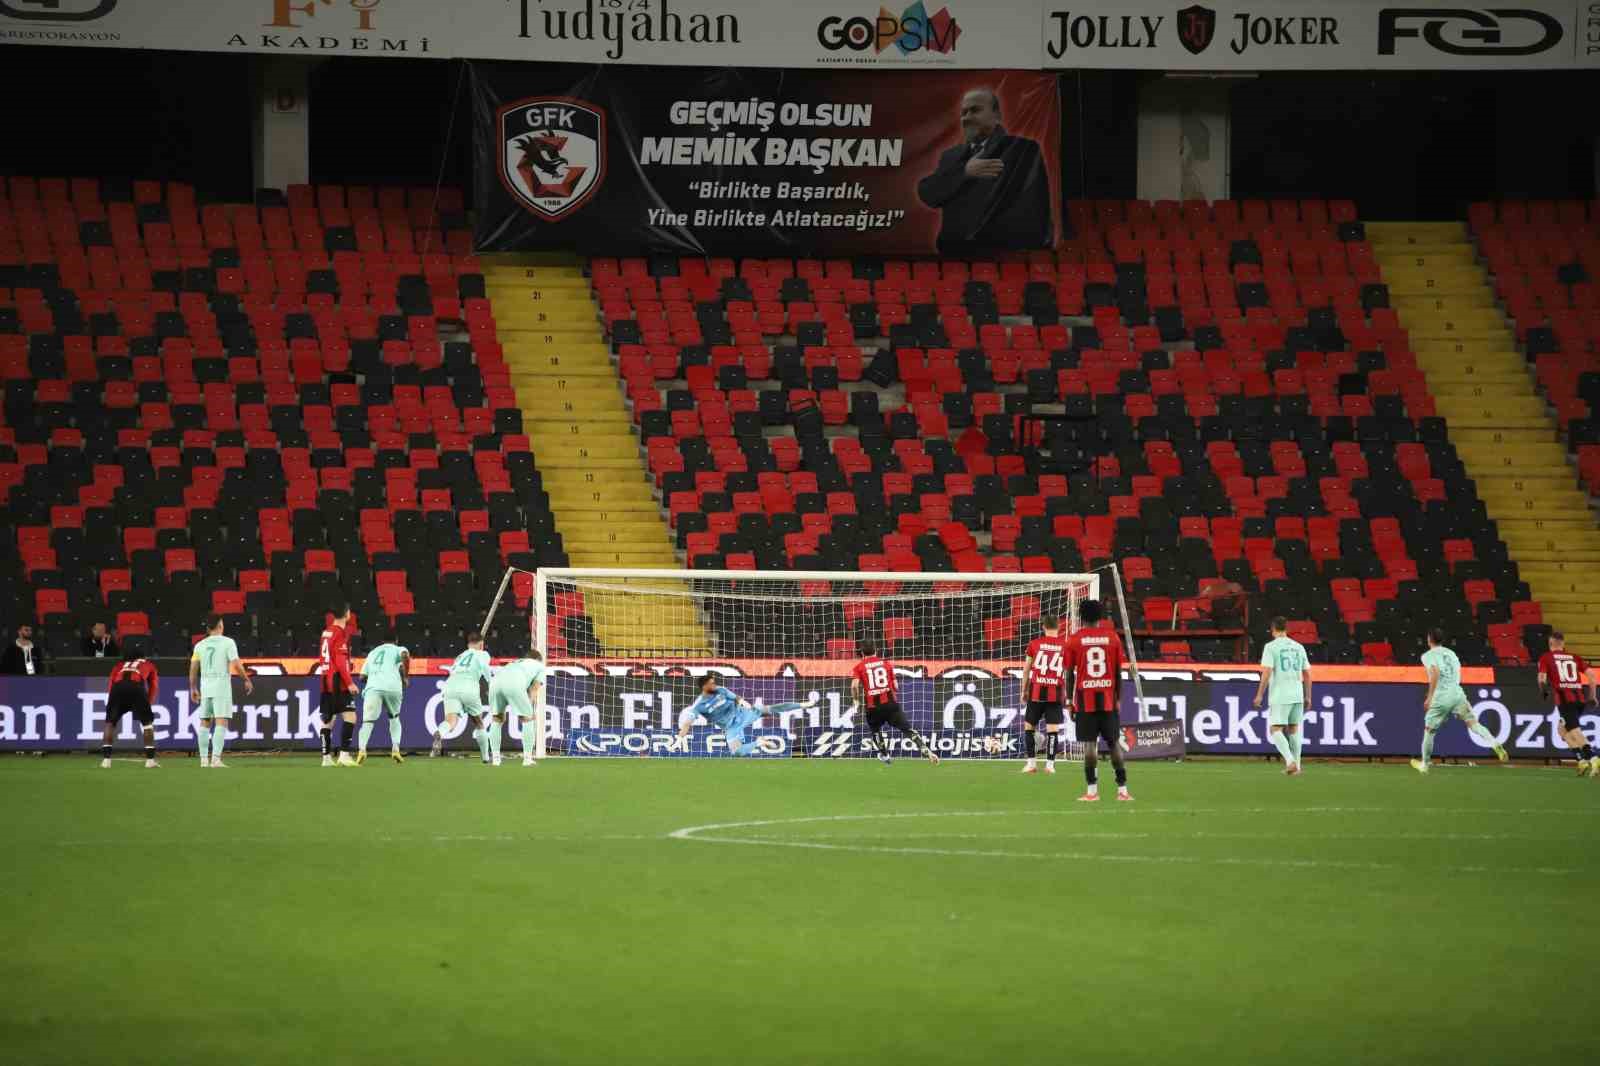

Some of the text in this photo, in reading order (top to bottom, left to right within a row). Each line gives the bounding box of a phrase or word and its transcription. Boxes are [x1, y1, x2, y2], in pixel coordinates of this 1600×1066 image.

[226, 34, 429, 53] AKADEMİ
[1048, 12, 1340, 59] JOLLY JOKER
[1378, 8, 1563, 56] FGD
[526, 107, 577, 128] GFK
[670, 98, 873, 132] GEÇMİŞ OLSUN
[640, 132, 903, 175] MEMİK BAŞKAN
[777, 182, 869, 201] Başardık,
[648, 208, 688, 227] Yine
[694, 208, 766, 228] Birlikte
[205, 646, 217, 673] 7
[1034, 651, 1063, 676] 44
[1086, 647, 1107, 678] 8
[1555, 660, 1578, 682] 10
[867, 667, 889, 690] 18
[77, 690, 323, 740] Elekrik
[1134, 695, 1377, 745] Elekrik
